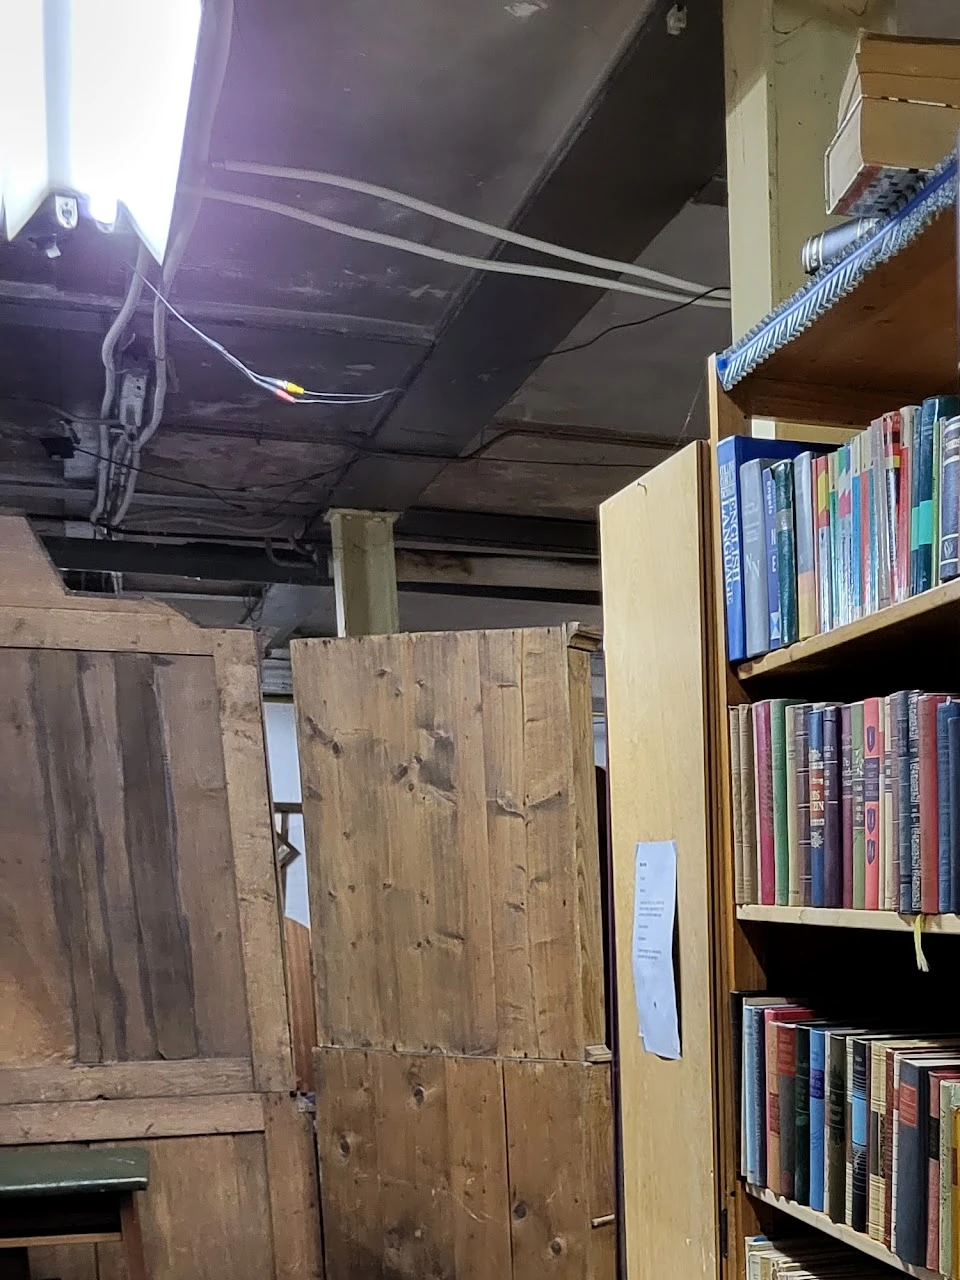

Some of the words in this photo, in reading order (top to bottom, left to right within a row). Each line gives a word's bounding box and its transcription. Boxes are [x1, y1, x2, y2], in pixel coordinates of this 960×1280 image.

[728, 496, 741, 583] ENGLISH
[766, 480, 775, 515] Engels
[720, 499, 734, 605] LANGUAGE
